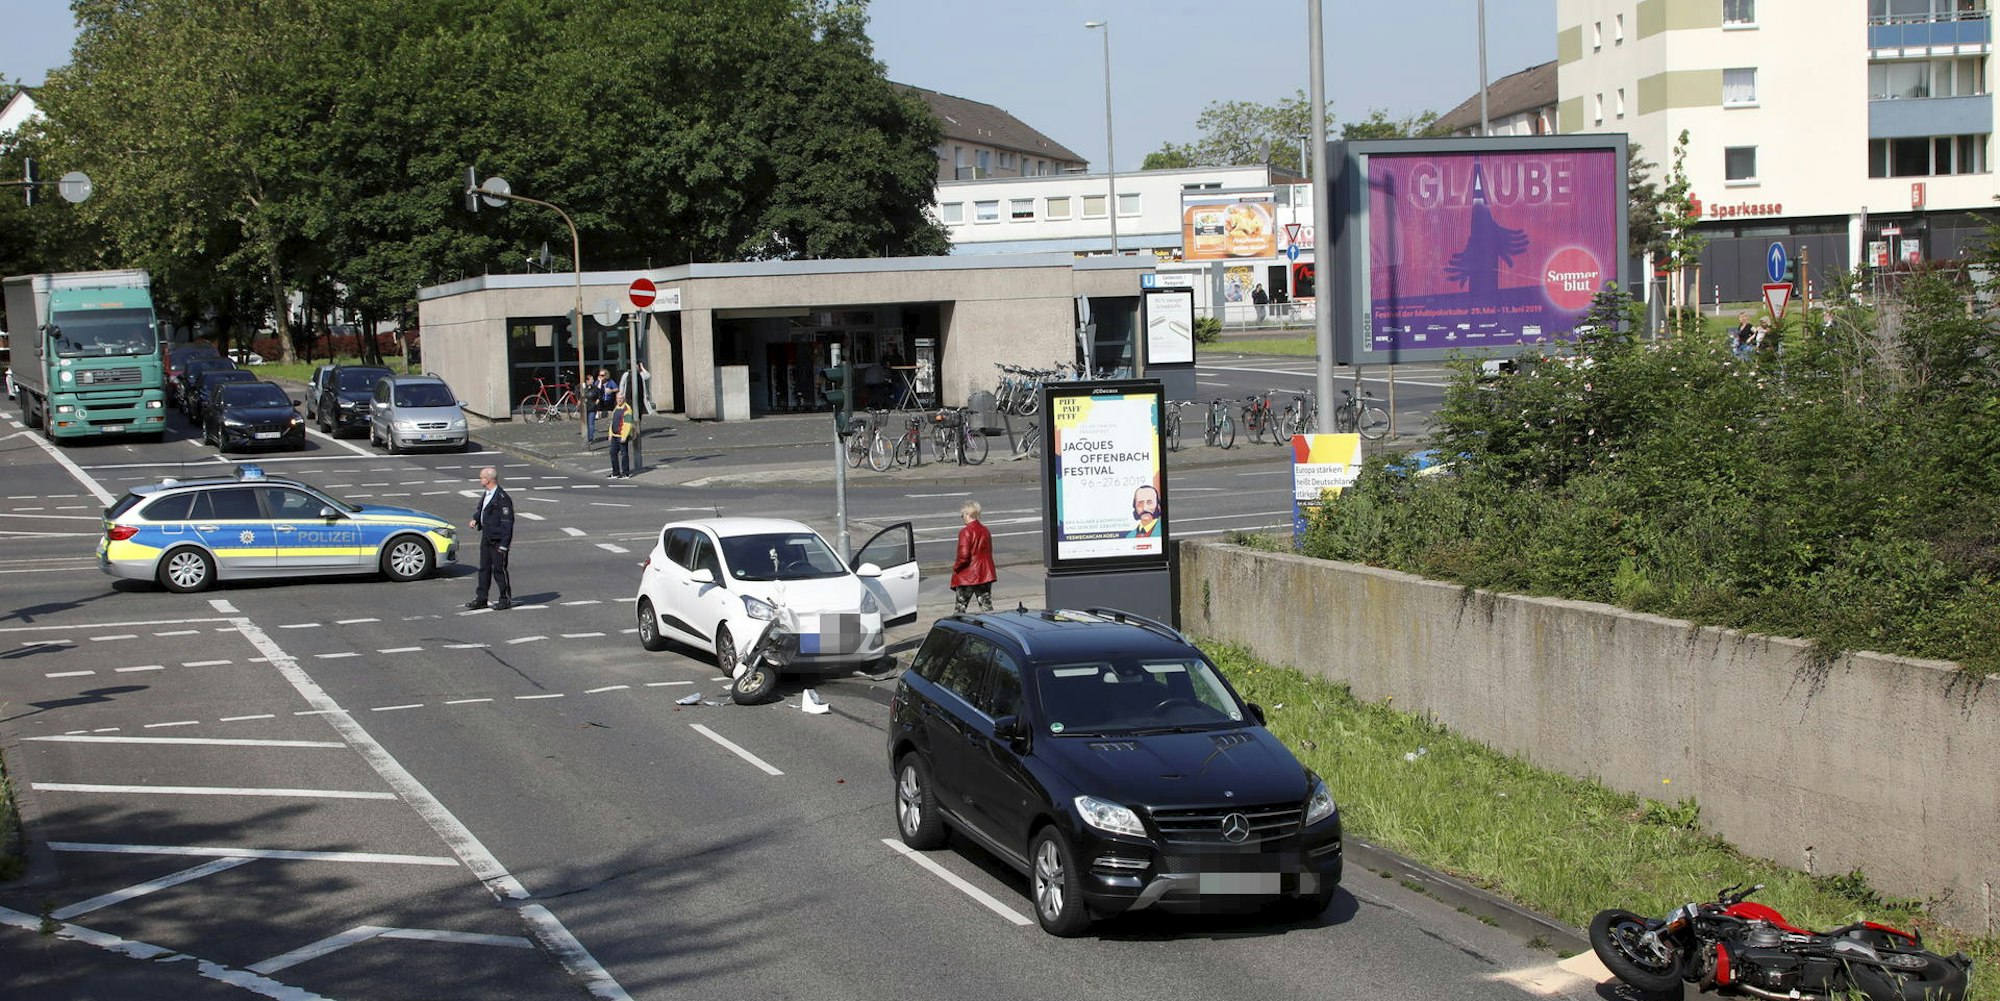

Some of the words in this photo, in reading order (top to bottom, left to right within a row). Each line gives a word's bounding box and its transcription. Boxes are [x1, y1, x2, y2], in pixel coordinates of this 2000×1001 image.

[1408, 159, 1571, 209] GLAUBE
[1710, 202, 1782, 219] Sparkasse
[1145, 275, 1153, 286] U
[1548, 270, 1598, 282] Sommer
[1564, 280, 1591, 291] blut
[1063, 441, 1113, 451] JACQUES
[1080, 452, 1149, 463] OFFENBACH
[1064, 466, 1114, 476] FESTIVAL
[298, 531, 355, 542] POLIZEI
